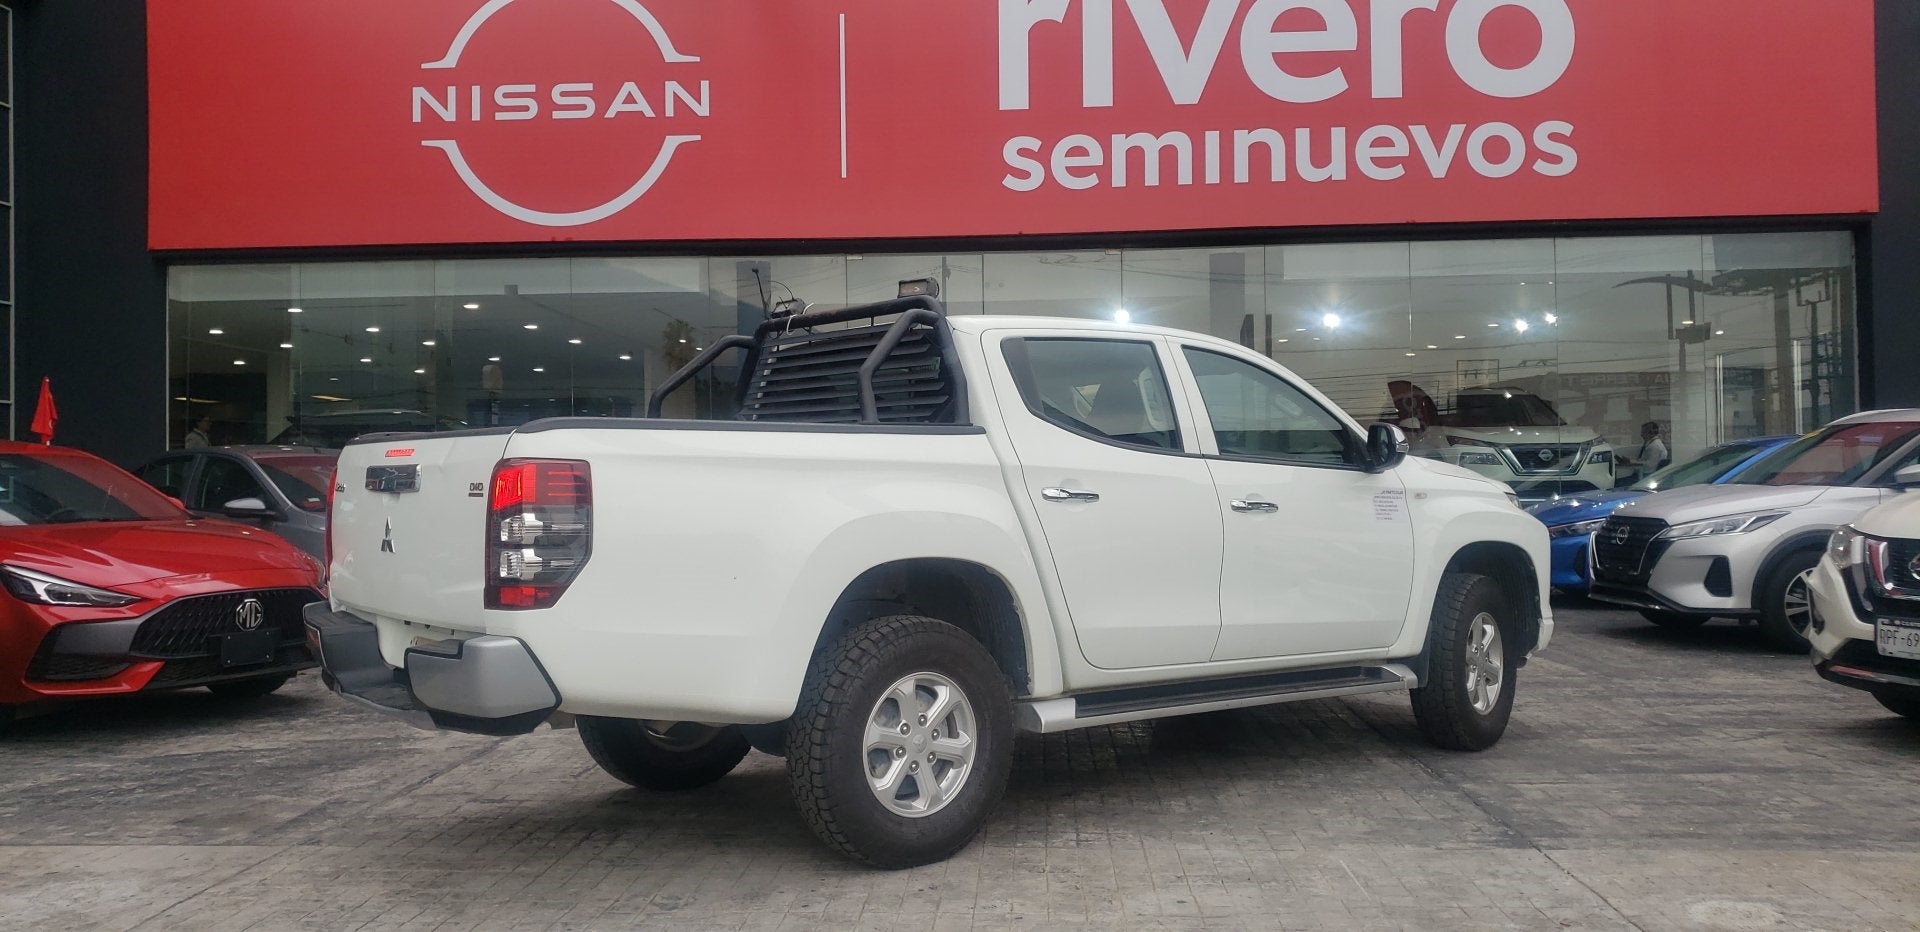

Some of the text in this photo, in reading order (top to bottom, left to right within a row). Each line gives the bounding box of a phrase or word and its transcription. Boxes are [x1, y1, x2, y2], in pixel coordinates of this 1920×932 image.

[998, 0, 1577, 111] rivero
[412, 80, 710, 123] NISSAN
[1001, 120, 1579, 192] seminuevos
[238, 601, 262, 629] MG
